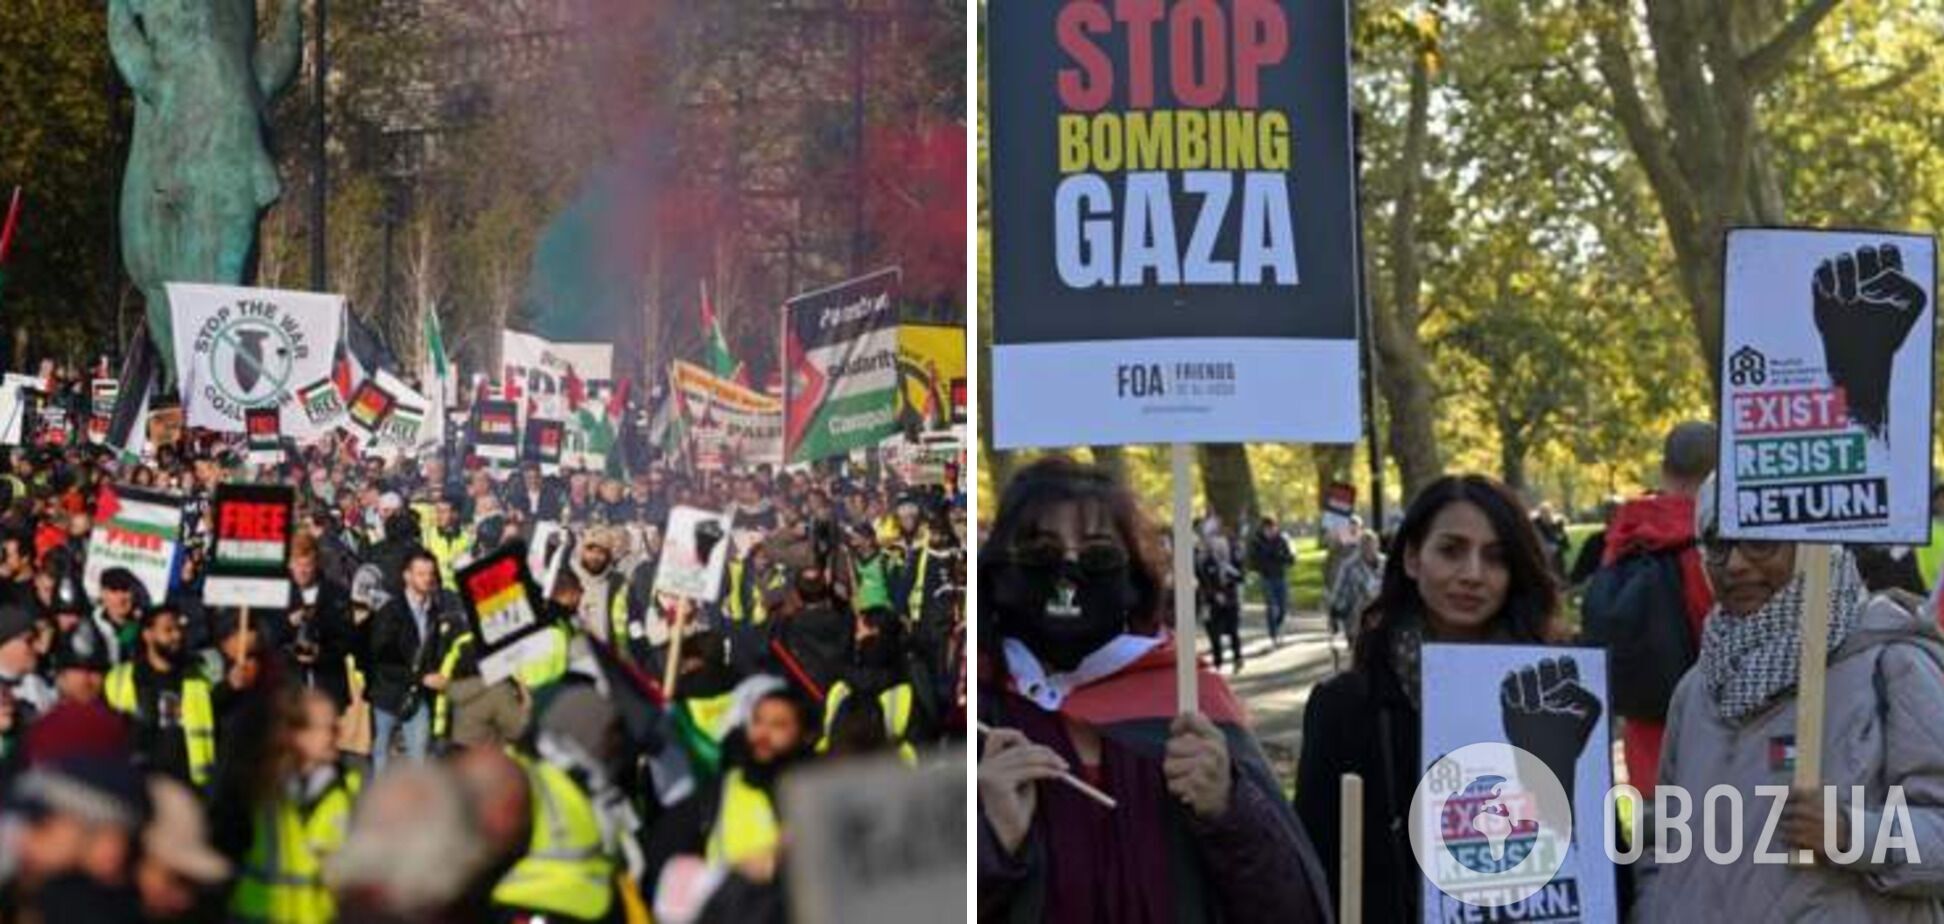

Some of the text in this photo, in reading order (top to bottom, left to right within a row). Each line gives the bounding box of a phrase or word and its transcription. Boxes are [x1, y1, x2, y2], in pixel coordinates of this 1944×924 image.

[1056, 0, 1290, 110] STOP
[1058, 110, 1291, 173] BOMBING
[1054, 171, 1300, 289] GAZA
[194, 300, 309, 360] STOP THE WAR
[1117, 363, 1165, 398] FOA
[1734, 392, 1846, 430] EXIST.
[1735, 438, 1866, 477] RESIST.
[221, 502, 287, 542] FREE
[1738, 480, 1888, 524] RETURN.
[1440, 883, 1580, 924] RETURN.
